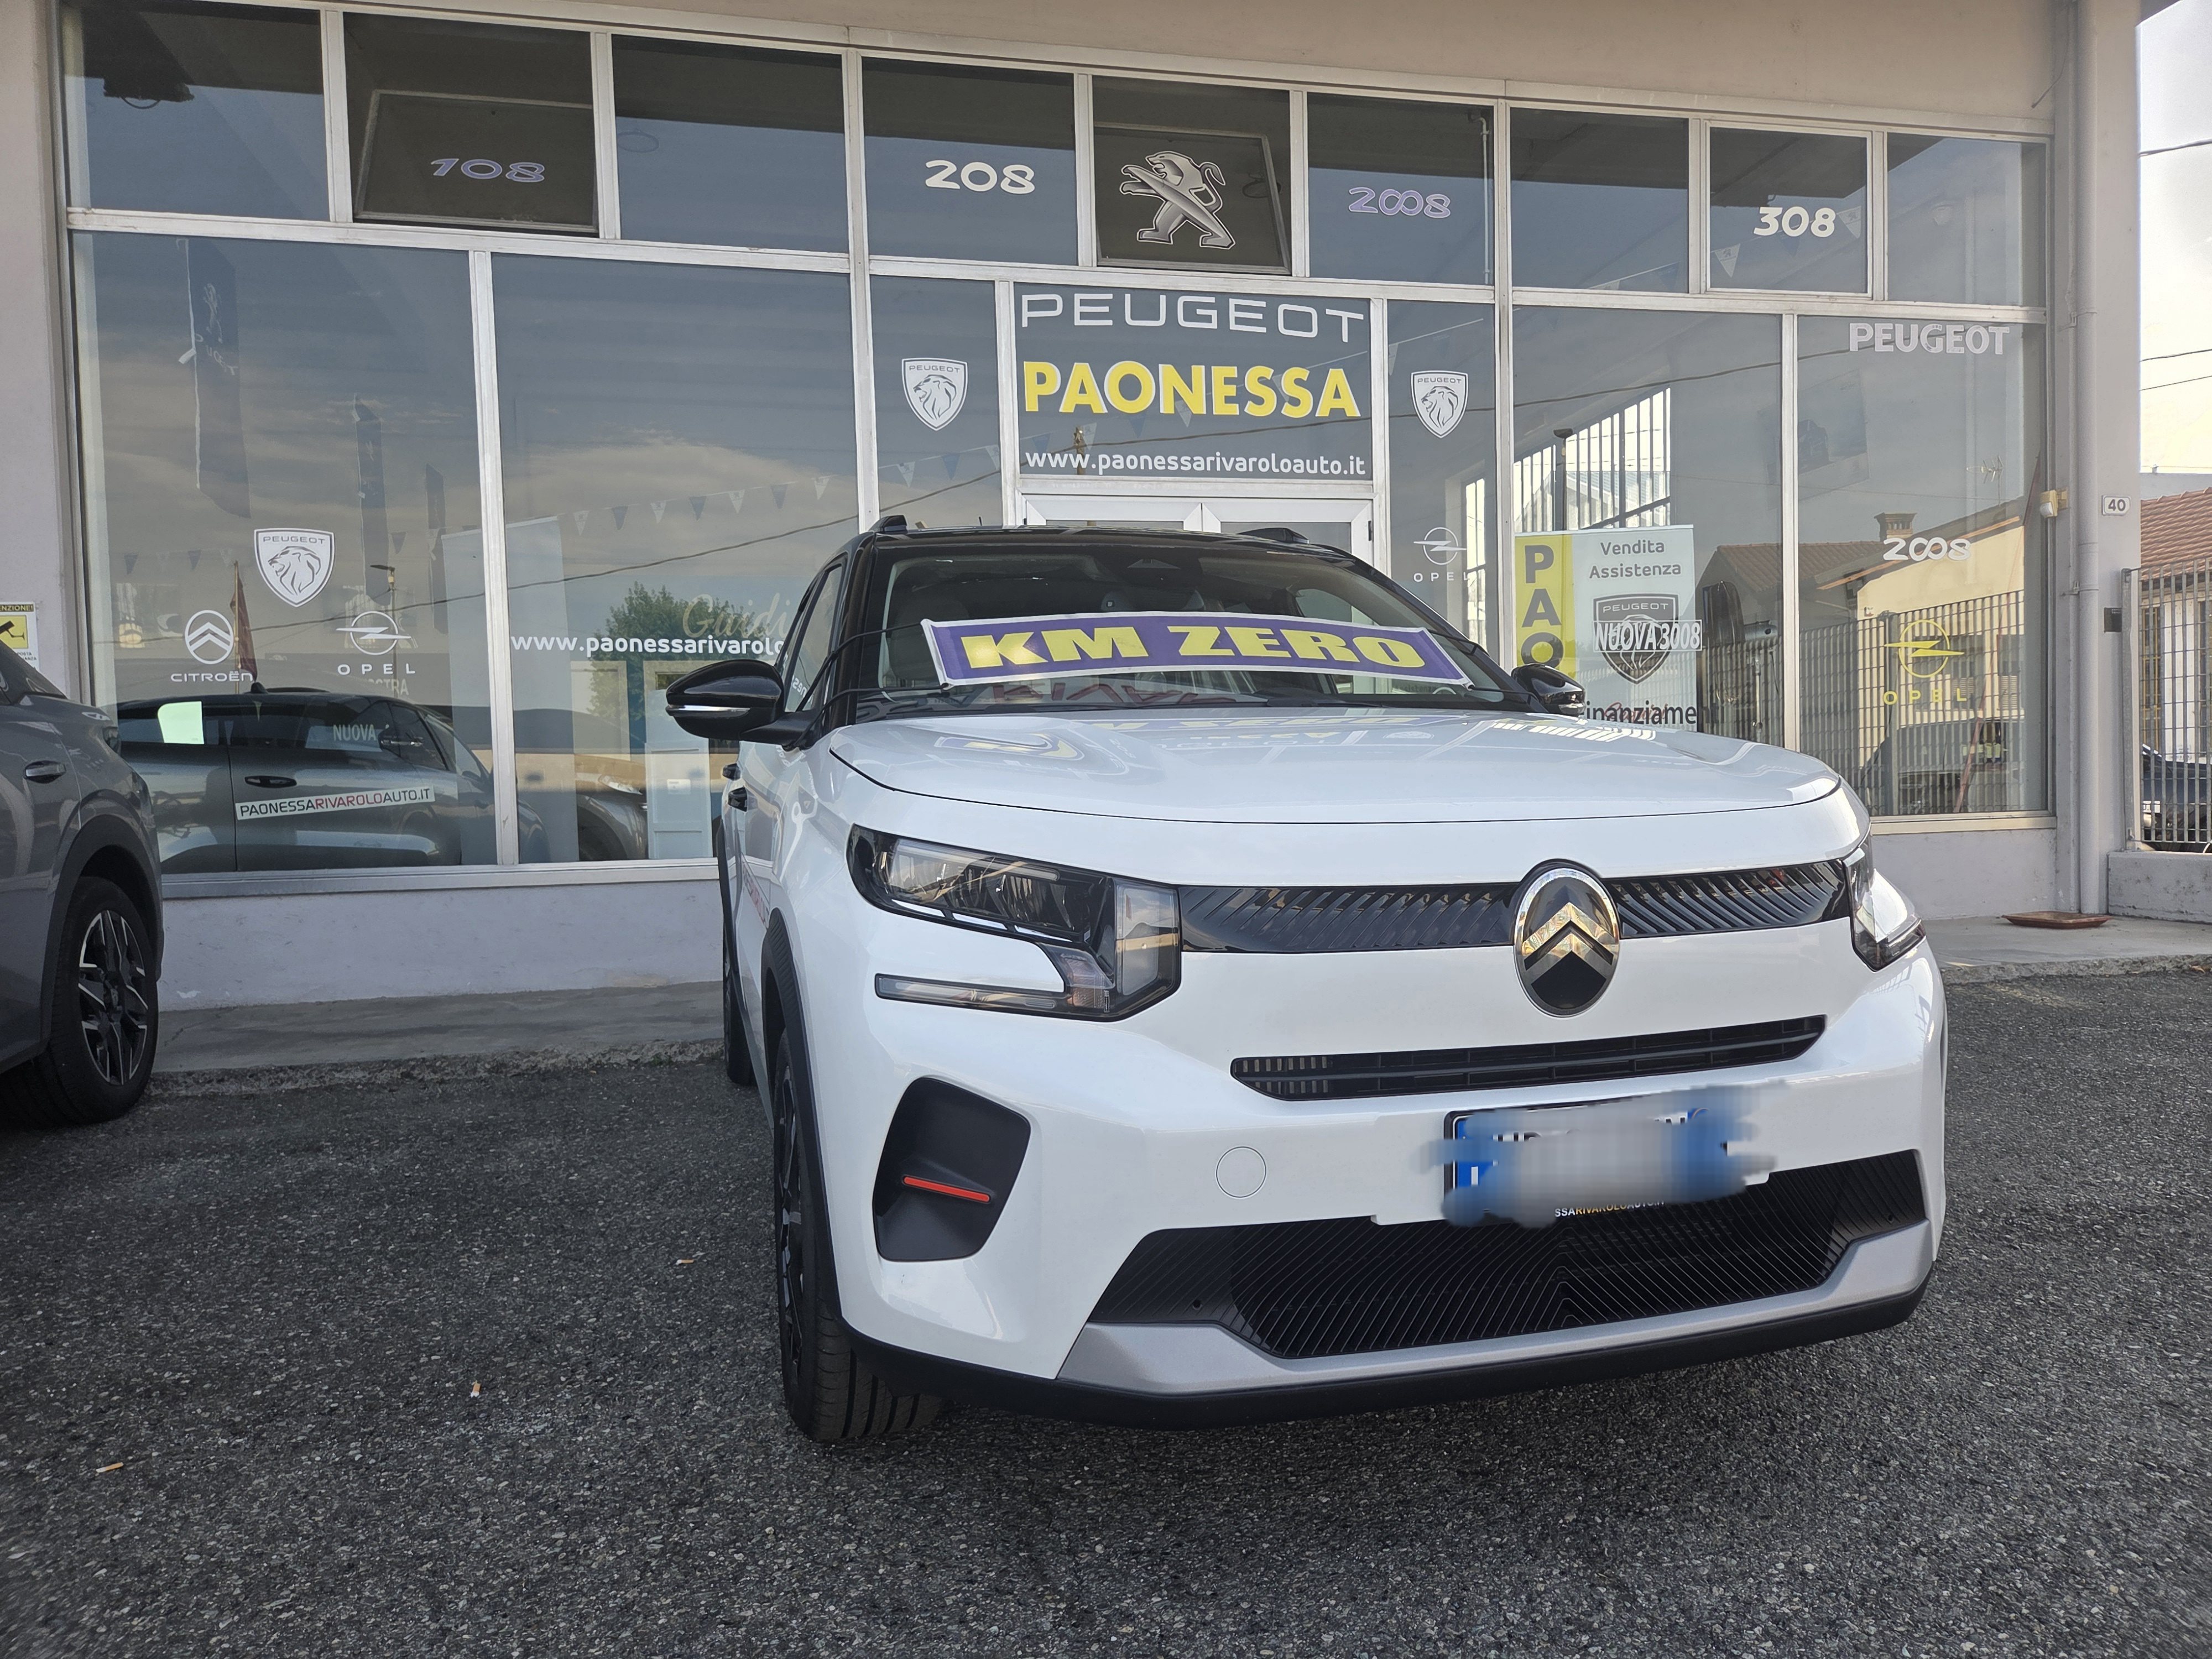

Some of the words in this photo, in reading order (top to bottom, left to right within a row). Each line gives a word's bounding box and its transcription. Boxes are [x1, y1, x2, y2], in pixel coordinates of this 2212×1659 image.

[431, 158, 545, 182] 108
[925, 159, 1035, 194] 208
[1348, 186, 1451, 219] 2008
[1753, 206, 1837, 238] 308
[1021, 293, 1365, 343] PEUGEOT
[1849, 322, 2011, 356] PEUGEOT
[909, 364, 961, 374] PEUGEOT
[1417, 377, 1462, 385] PEUGEOT
[1023, 360, 1361, 418] PAONESSA
[1025, 449, 1366, 476] www.paonessarivaroloauto.it
[2108, 499, 2126, 512] 40
[263, 535, 326, 545] PEUGEOT
[1600, 539, 1665, 556] Vendita
[1883, 536, 1972, 561] 2008
[1413, 572, 1469, 583] OPEL
[1589, 563, 1682, 579] Assistenza
[1603, 602, 1669, 613] PEUGEOT
[960, 625, 1149, 669] KM
[1168, 625, 1425, 668] ZERO
[1595, 623, 1656, 650] NUOVA
[1660, 622, 1701, 650] 3008
[337, 663, 415, 675] OPEL
[1883, 688, 1967, 705] OPEL
[333, 724, 377, 742] NUOVA
[239, 787, 430, 817] PAONESSARIVAROLOAUTO.IT
